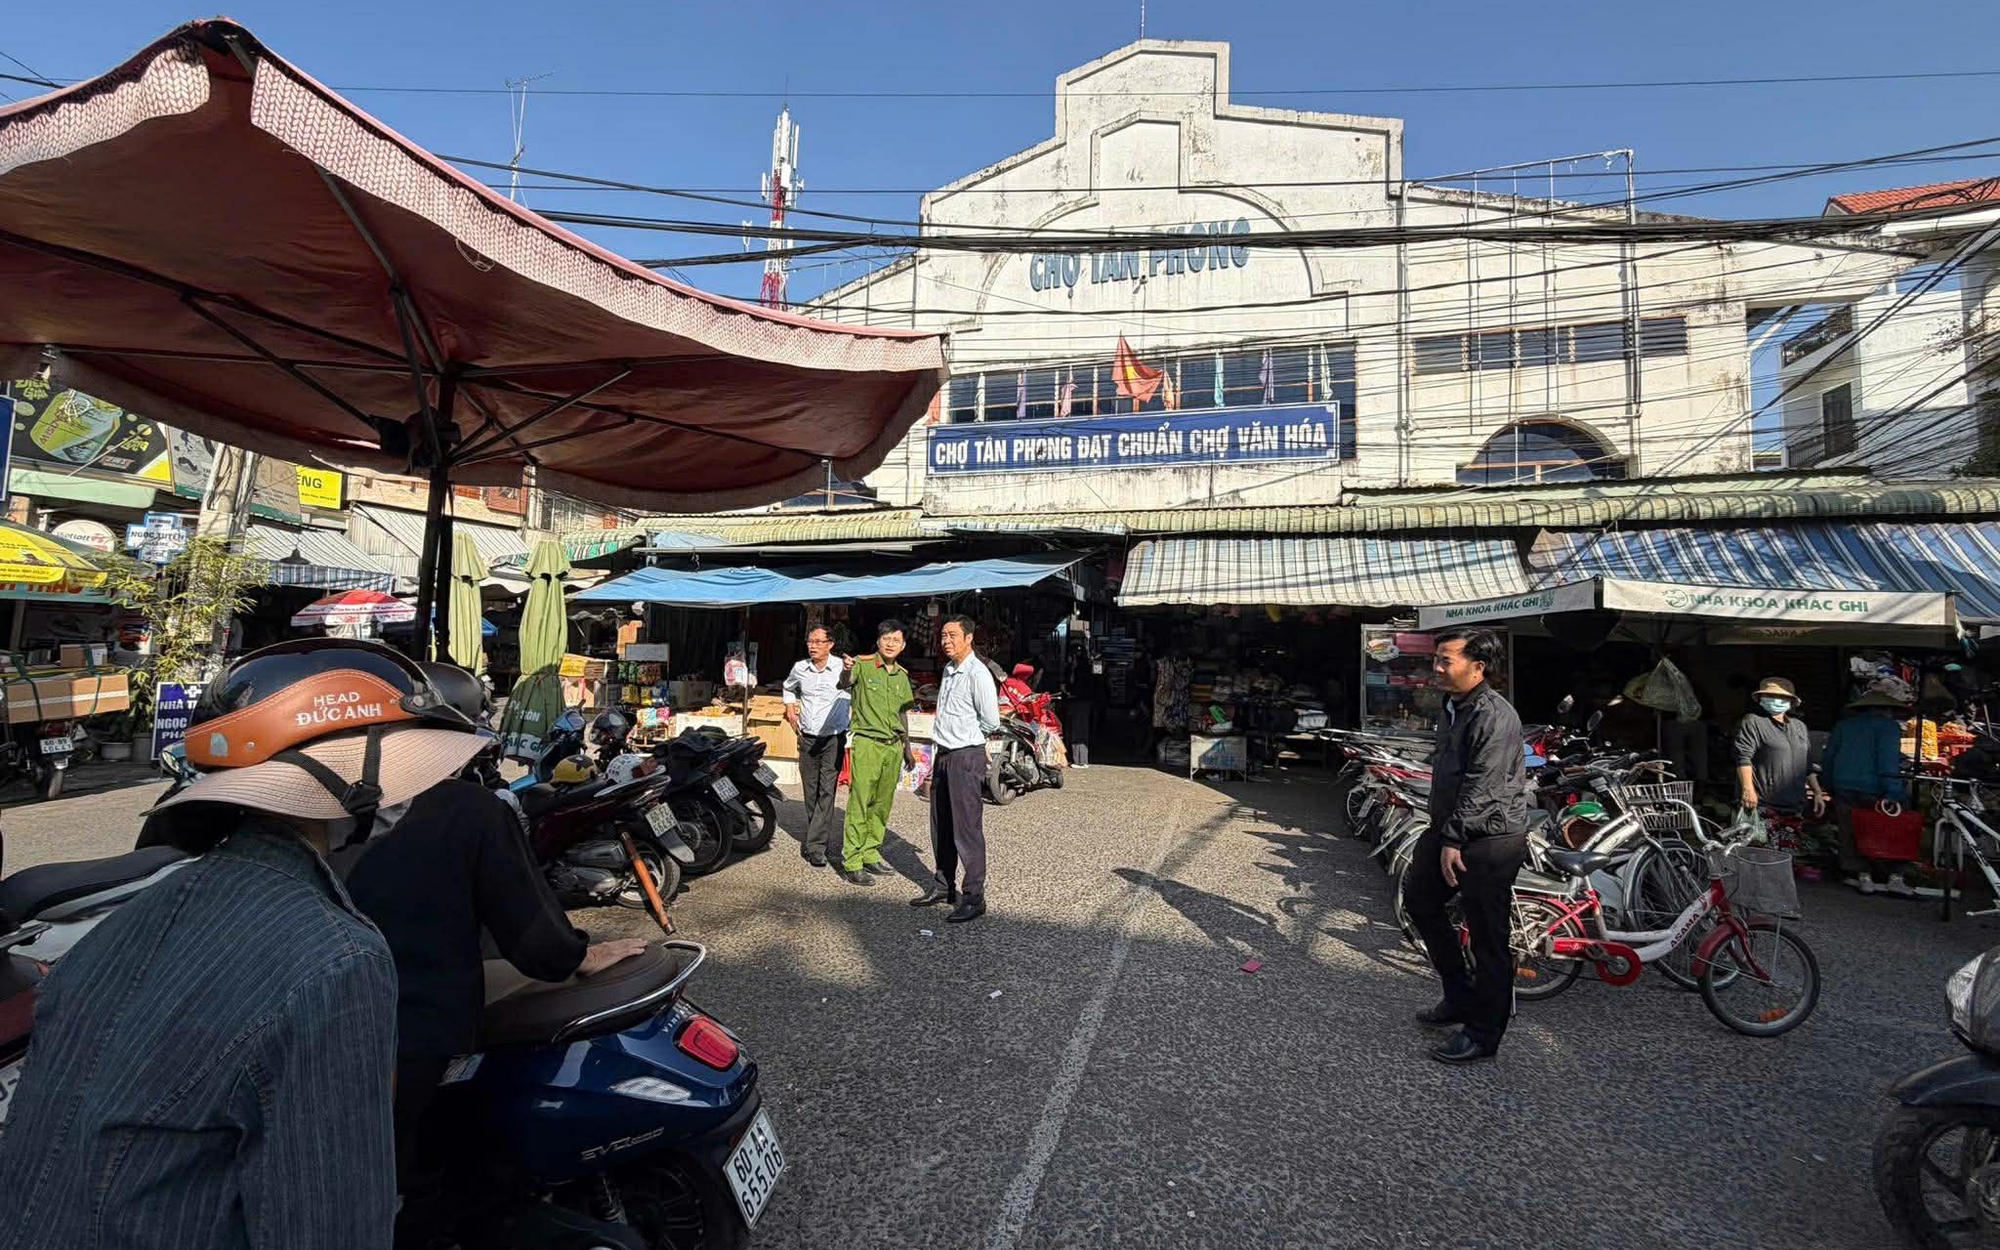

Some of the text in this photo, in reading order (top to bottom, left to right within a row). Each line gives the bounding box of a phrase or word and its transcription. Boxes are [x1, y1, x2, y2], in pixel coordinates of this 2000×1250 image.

[1149, 217, 1251, 278] PHONG
[935, 418, 1328, 470] CHỢ TÂN PHONG ĐẠT CHUẨN CHỢ VĂN HÓA
[1446, 607, 1464, 619] NHA
[1465, 604, 1491, 616] KHOA
[1521, 598, 1539, 609] GHI
[1690, 594, 1725, 606] NHA
[1729, 596, 1779, 609] KHOA
[1838, 600, 1869, 613] GHI
[313, 692, 360, 707] HEAD
[157, 717, 188, 730] NGỌC
[296, 703, 382, 727] ĐỨC ANH
[1671, 913, 1700, 950] ASAMA
[742, 1143, 783, 1218] 655.06
